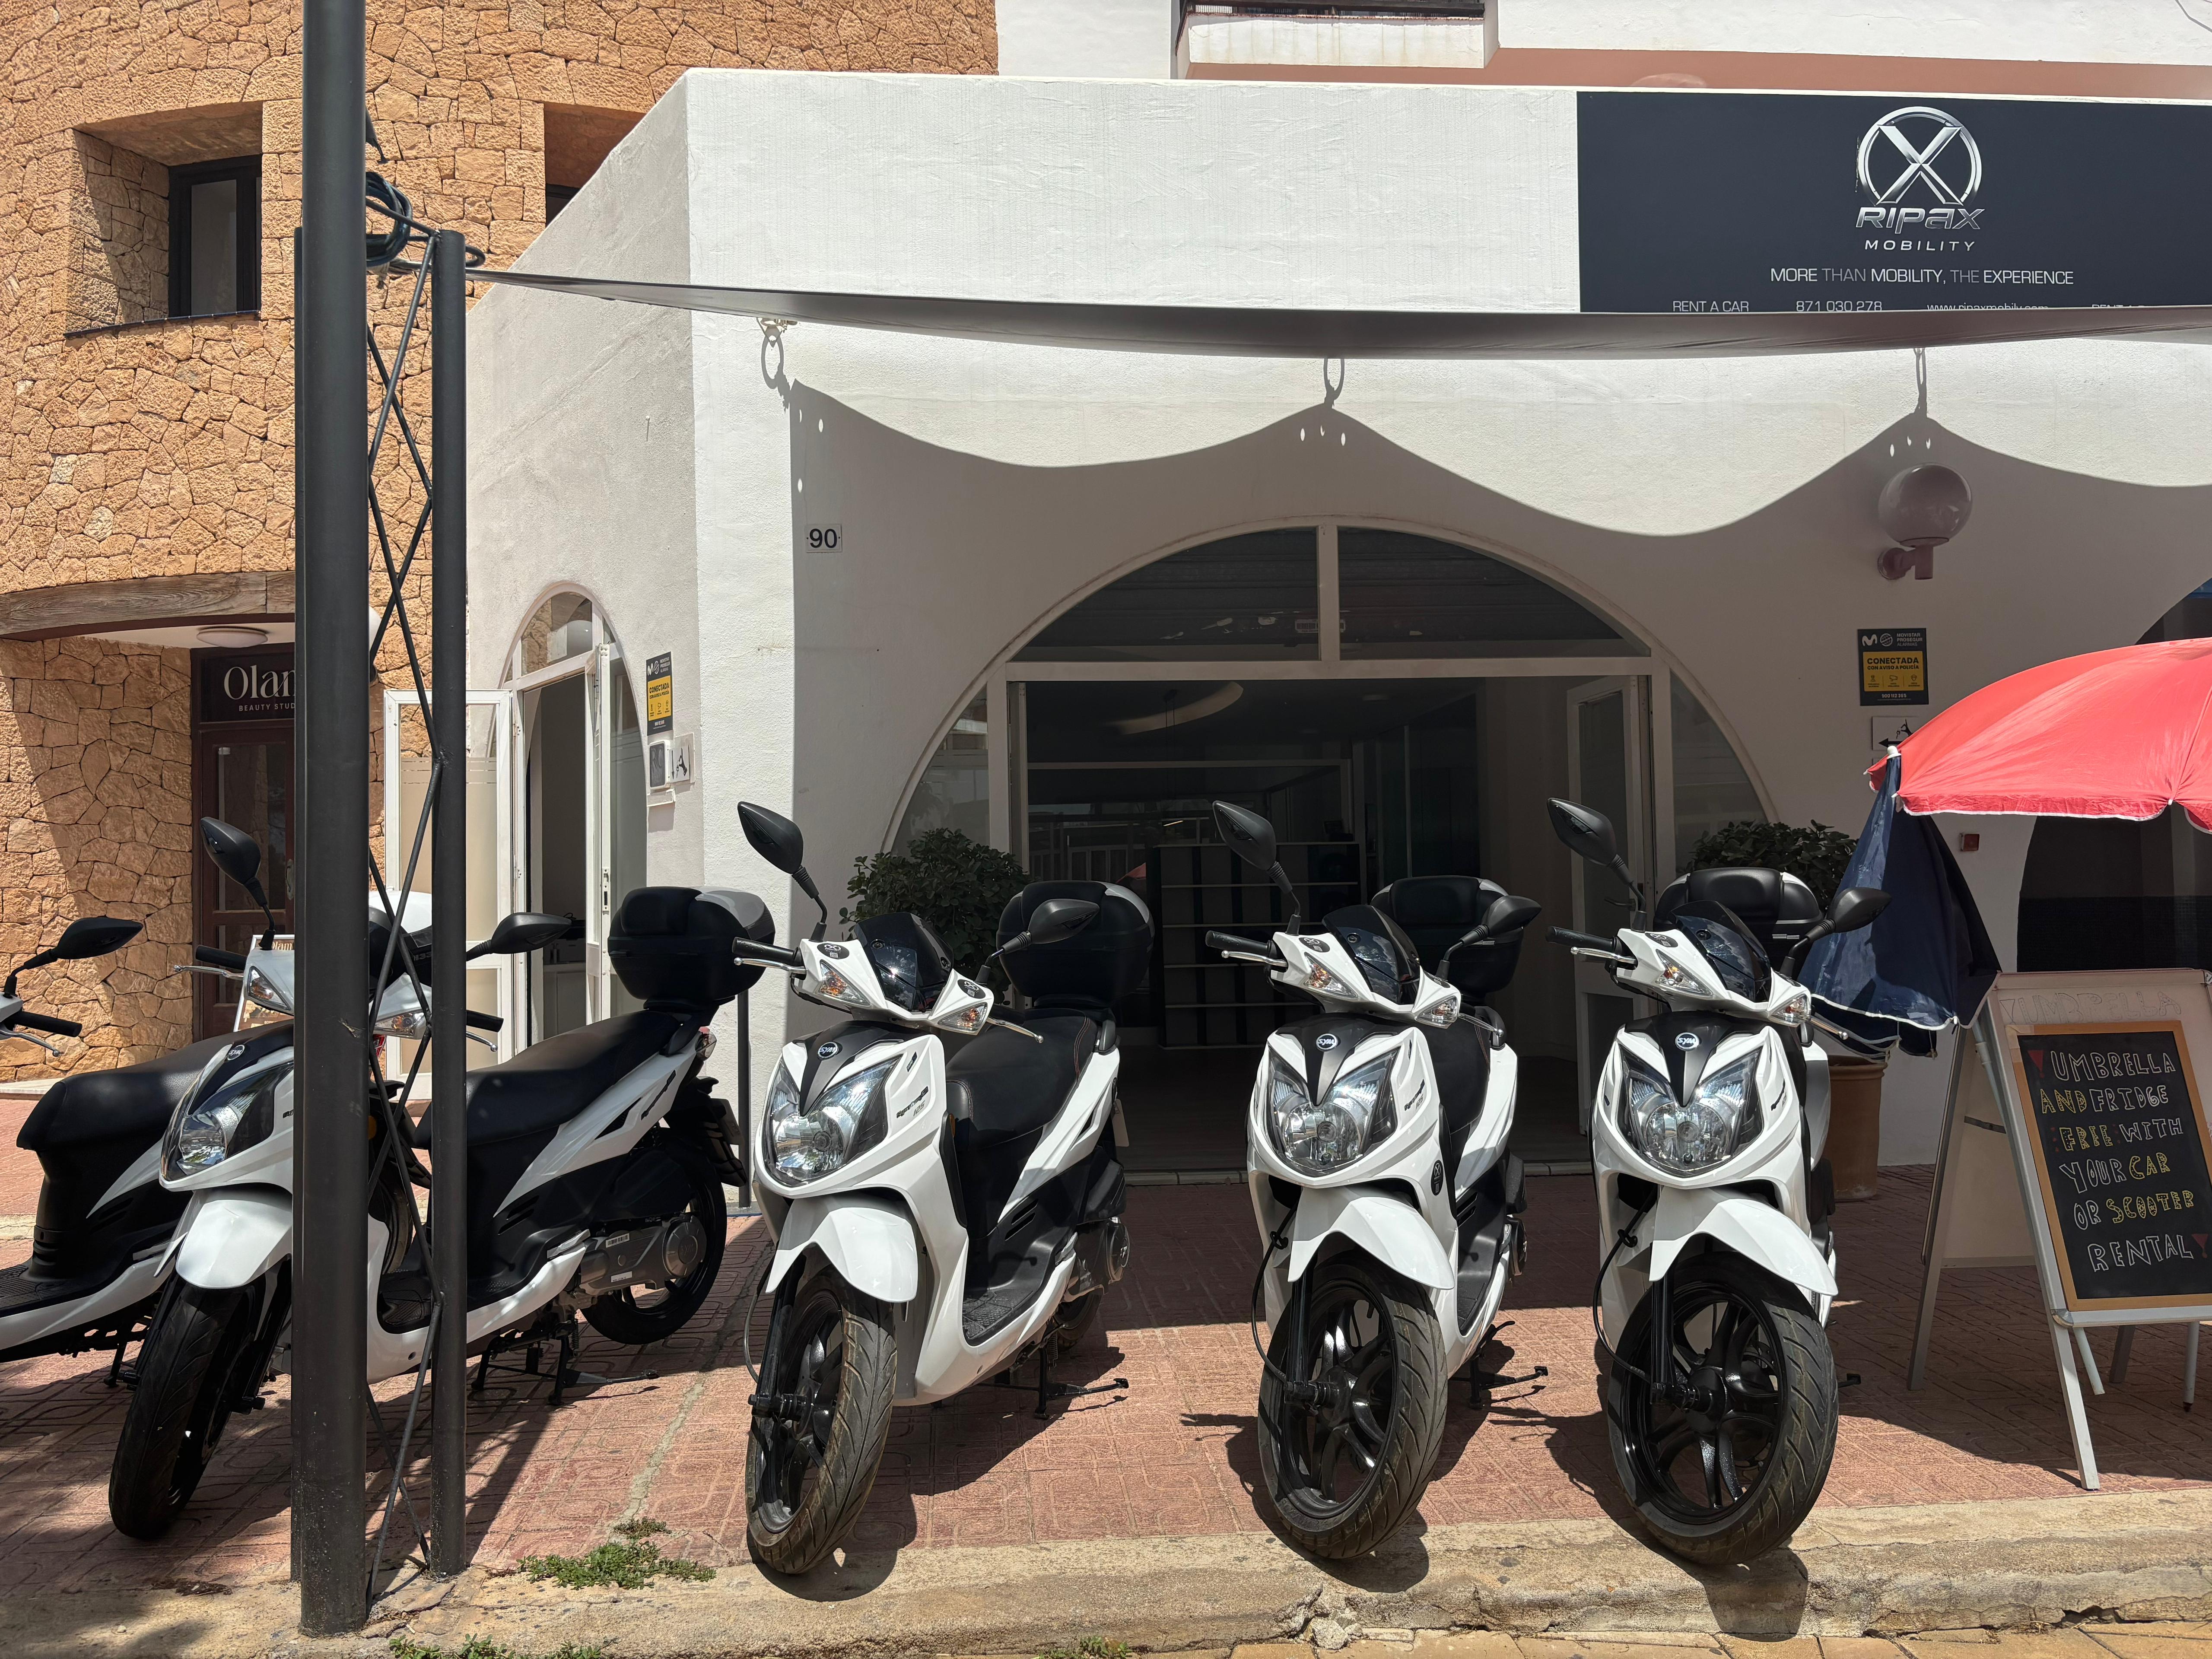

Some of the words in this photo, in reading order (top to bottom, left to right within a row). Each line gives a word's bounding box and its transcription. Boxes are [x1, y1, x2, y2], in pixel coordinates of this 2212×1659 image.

[1865, 240, 1975, 251] MOBILITY
[1771, 268, 1818, 282] MORE
[1821, 268, 1866, 282] THAN
[1871, 269, 1946, 284] MOBILITY,
[1950, 270, 1980, 283] THE
[1983, 270, 2074, 285] EXPERIENCE
[1673, 301, 1707, 312] RENT
[1710, 301, 1719, 312] A
[1723, 301, 1749, 312] CAR
[1796, 301, 1821, 311] 871
[1826, 301, 1853, 311] 030
[1856, 301, 1882, 311] 278
[809, 528, 837, 548] 90
[649, 684, 670, 694] CONECTADA
[2050, 1050, 2176, 1082] UMBRELLA
[913, 1100, 925, 1117] 125
[2040, 1088, 2087, 1114] AND
[2089, 1085, 2169, 1112] FRIDGE
[2119, 1118, 2183, 1143] WITH
[2059, 1158, 2127, 1194] YOUR
[2129, 1152, 2171, 1179] CAR
[2074, 1200, 2101, 1230] OR
[2106, 1190, 2194, 1224] SCOOTER
